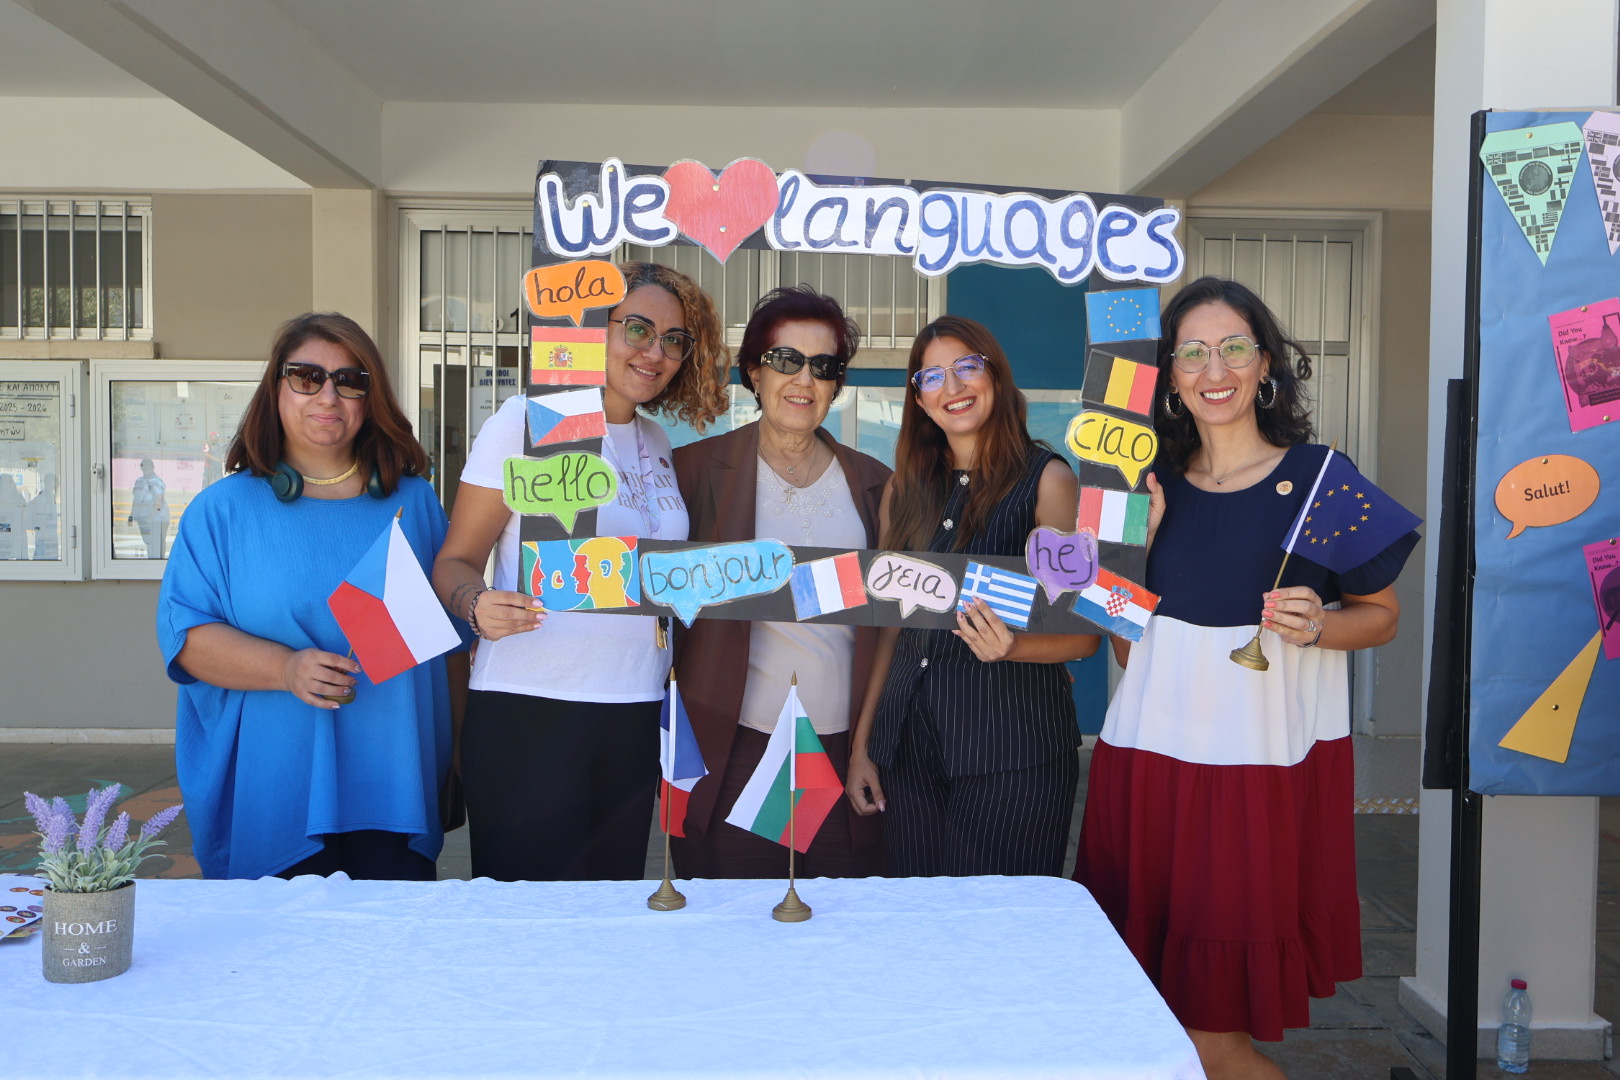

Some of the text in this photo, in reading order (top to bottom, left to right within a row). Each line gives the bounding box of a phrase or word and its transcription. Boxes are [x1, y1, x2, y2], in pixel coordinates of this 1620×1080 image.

[546, 164, 1180, 281] We languages
[534, 266, 614, 305] hola
[1558, 329, 1569, 337] Did
[479, 378, 516, 386] ΔΙΕΥΥΝΤΕΣ
[27, 403, 47, 412] 2026
[1073, 418, 1154, 462] ciao
[509, 454, 611, 503] hello
[1524, 480, 1571, 502] Salut!
[1034, 532, 1093, 586] hej
[1592, 555, 1603, 564] Did
[647, 551, 786, 599] bonjour
[872, 560, 946, 599] γεια
[54, 919, 118, 936] HOME
[78, 942, 90, 954] &
[62, 956, 107, 967] GARDEN
